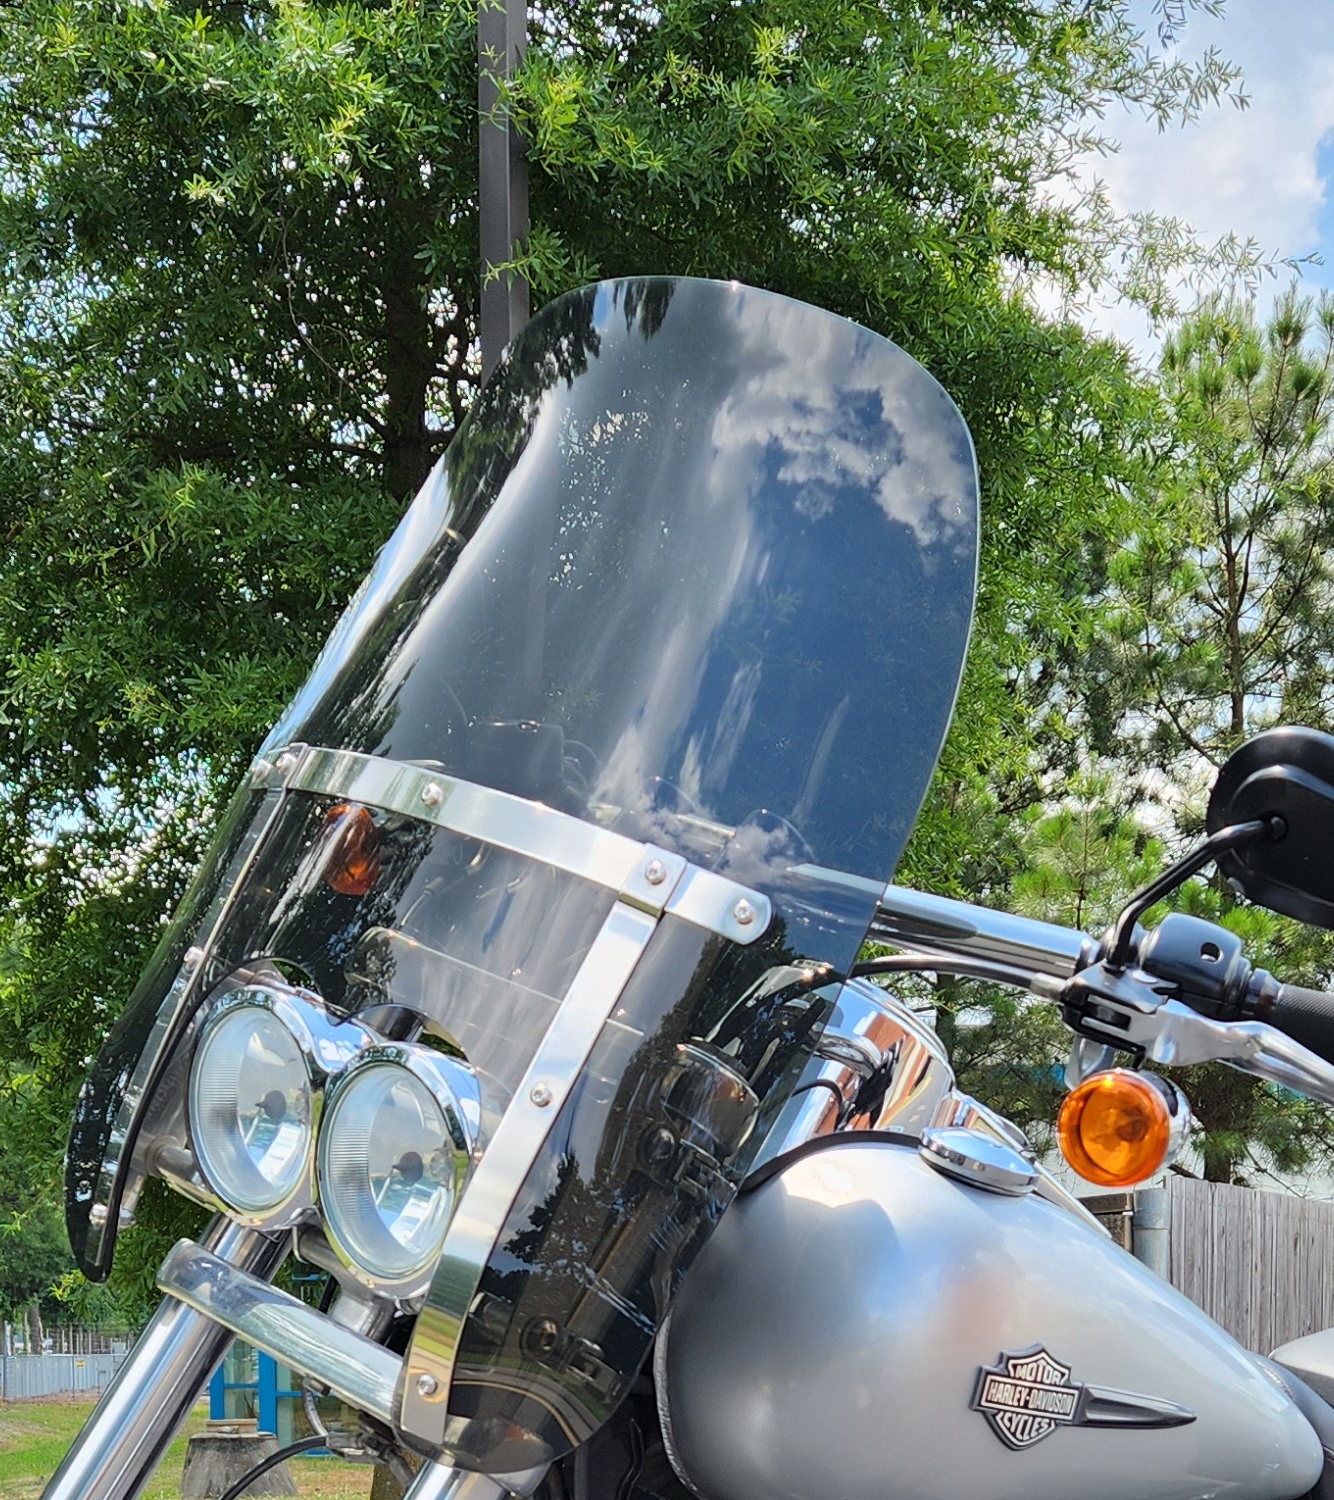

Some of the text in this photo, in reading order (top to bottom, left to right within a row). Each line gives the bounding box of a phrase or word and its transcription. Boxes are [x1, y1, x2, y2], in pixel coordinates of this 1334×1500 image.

[1014, 1358, 1067, 1386] MOTOR
[986, 1381, 1074, 1415] HARLEY-DAVIDSON
[1003, 1411, 1051, 1441] CYCLES
